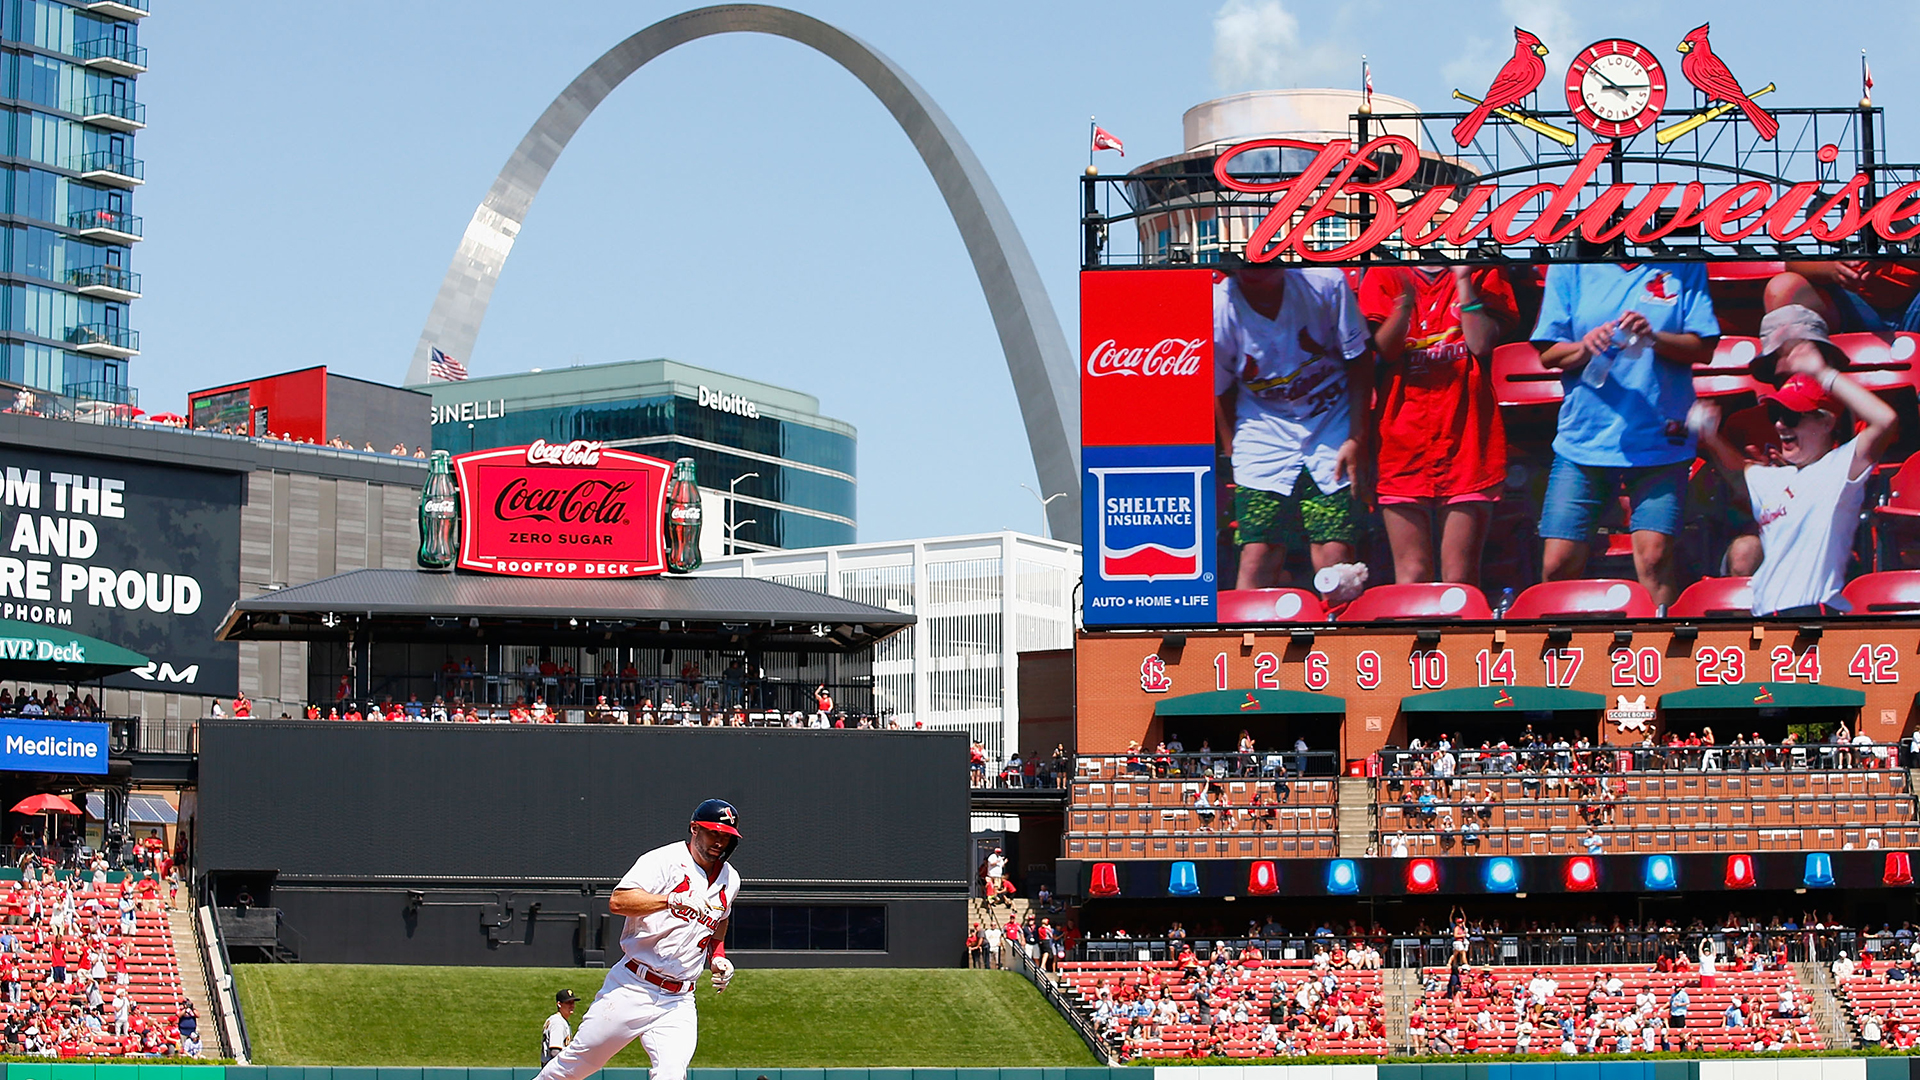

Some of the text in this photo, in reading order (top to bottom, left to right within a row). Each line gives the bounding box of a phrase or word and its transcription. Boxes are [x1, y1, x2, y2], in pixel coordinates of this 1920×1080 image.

[1607, 57, 1643, 77] LOUIS
[1585, 92, 1648, 120] CARDINALS
[1086, 338, 1207, 378] Coca-Cola
[698, 385, 760, 420] Deloitte.
[527, 439, 603, 466] Coca-Cola
[0, 466, 126, 519] M THE
[494, 477, 636, 525] Coca-Cola
[1106, 496, 1192, 514] SHELTER
[1107, 513, 1192, 526] INSURANCE
[9, 513, 99, 560] AND
[509, 533, 614, 546] ZERO SUGAR
[496, 561, 630, 575] ROOFTOP DECK
[61, 563, 204, 616] PROUD
[1092, 595, 1209, 608] AUTO HOME LIFE
[0, 603, 73, 626] PHORM
[37, 639, 85, 663] Deck
[1213, 652, 1228, 691] 1
[1254, 652, 1280, 690] 2
[1304, 651, 1330, 690] 6
[1356, 650, 1381, 689] 9
[1409, 650, 1448, 689] 10
[1476, 649, 1516, 687] 14
[1544, 648, 1584, 687] 17
[1611, 647, 1661, 686] 20
[1696, 646, 1745, 685] 23
[1771, 645, 1821, 683] 24
[1849, 644, 1899, 683] 42
[1609, 711, 1656, 719] SCOREBOARD
[6, 735, 98, 758] Medicine
